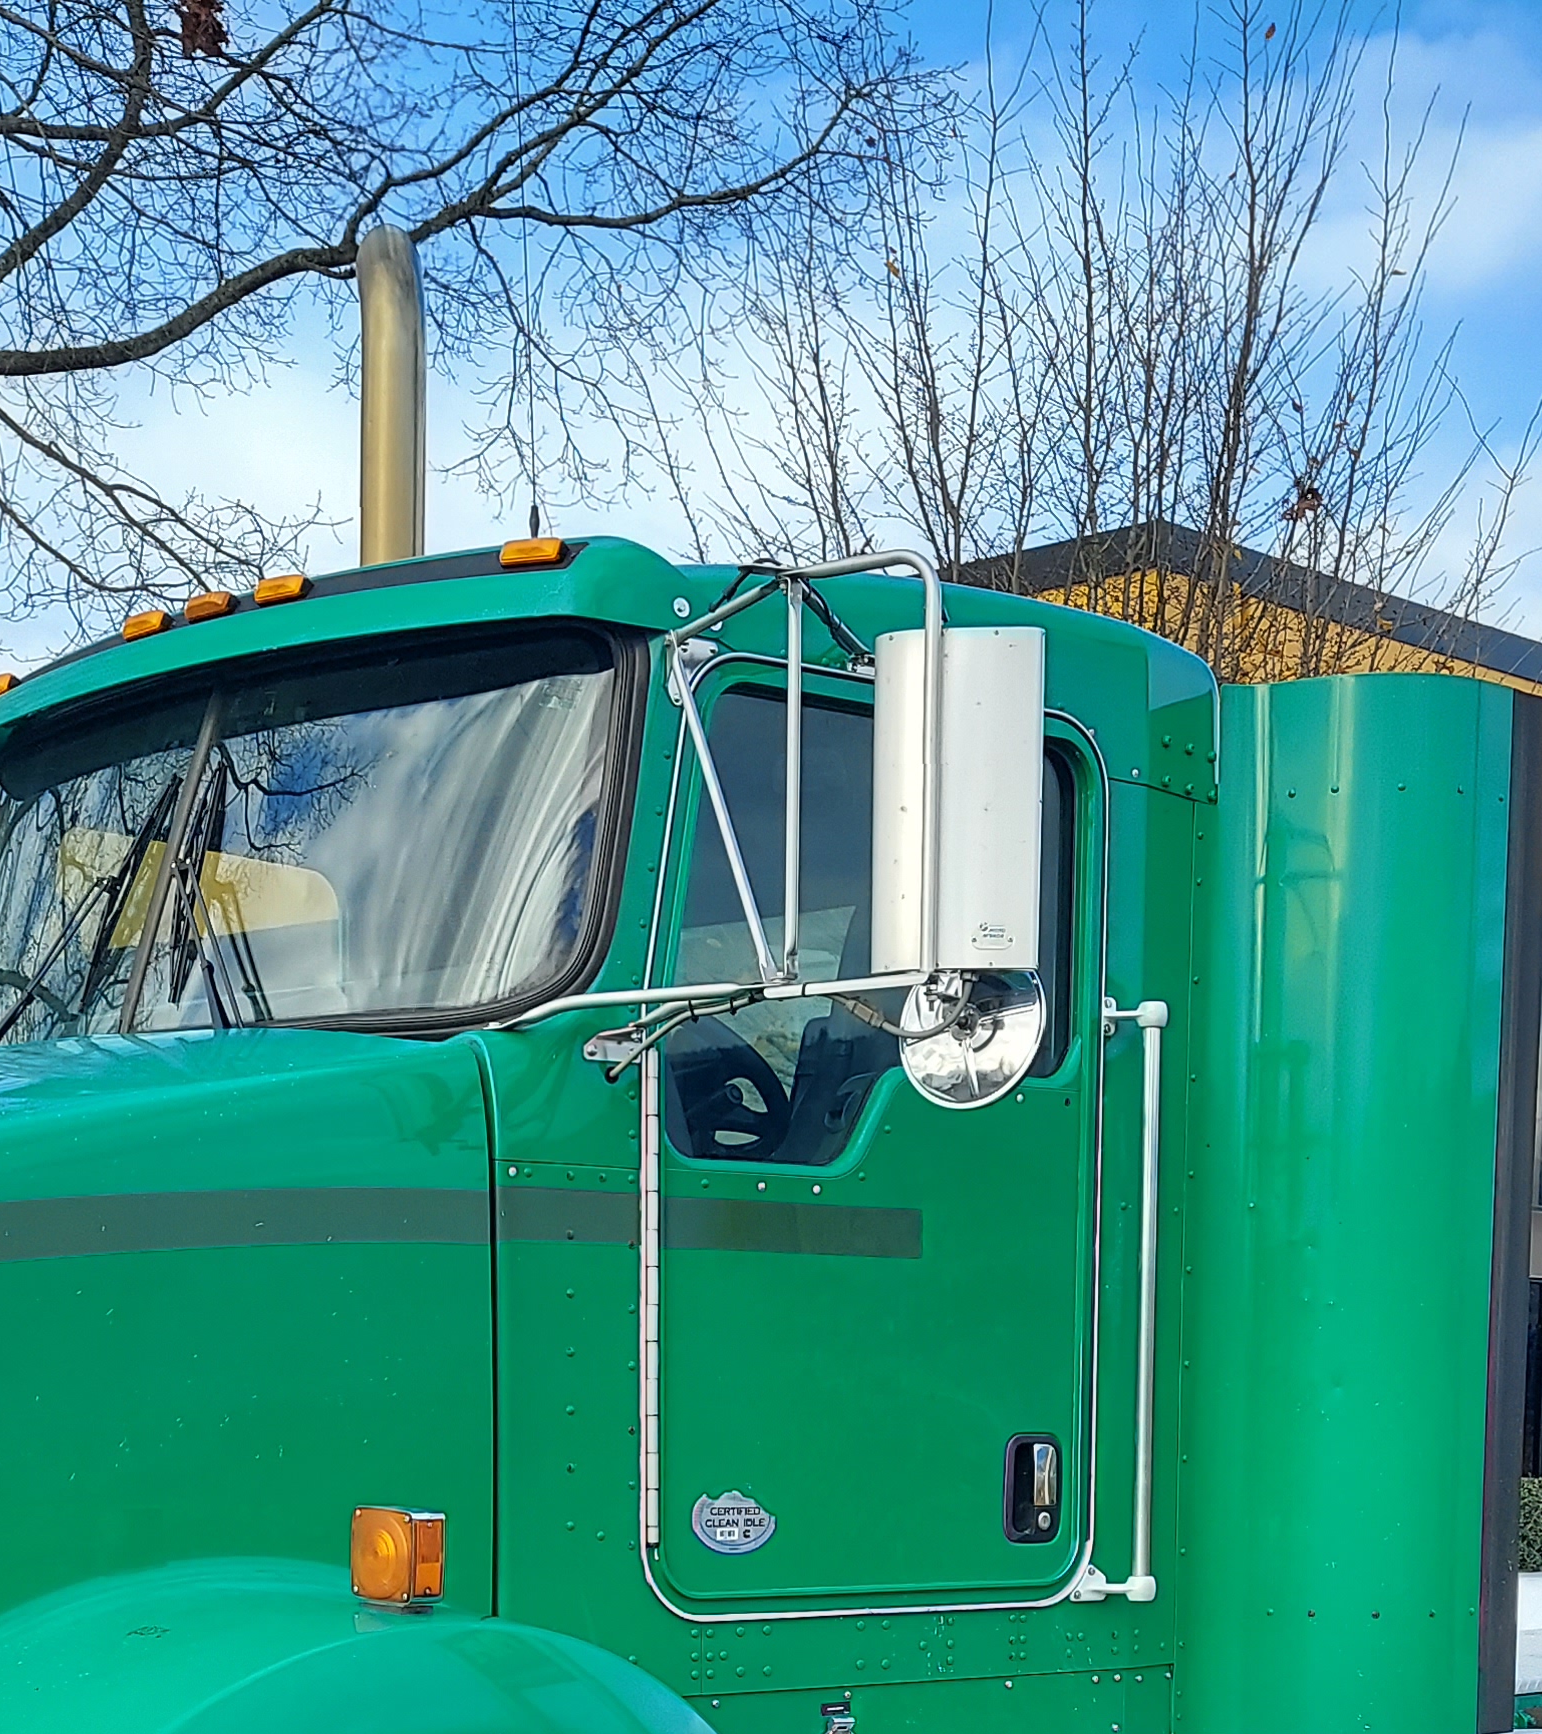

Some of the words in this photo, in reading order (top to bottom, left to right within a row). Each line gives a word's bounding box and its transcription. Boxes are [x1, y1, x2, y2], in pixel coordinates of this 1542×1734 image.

[710, 1506, 761, 1516] CERTIFIED
[705, 1518, 739, 1528] CLEAN
[743, 1518, 766, 1527] IDLE
